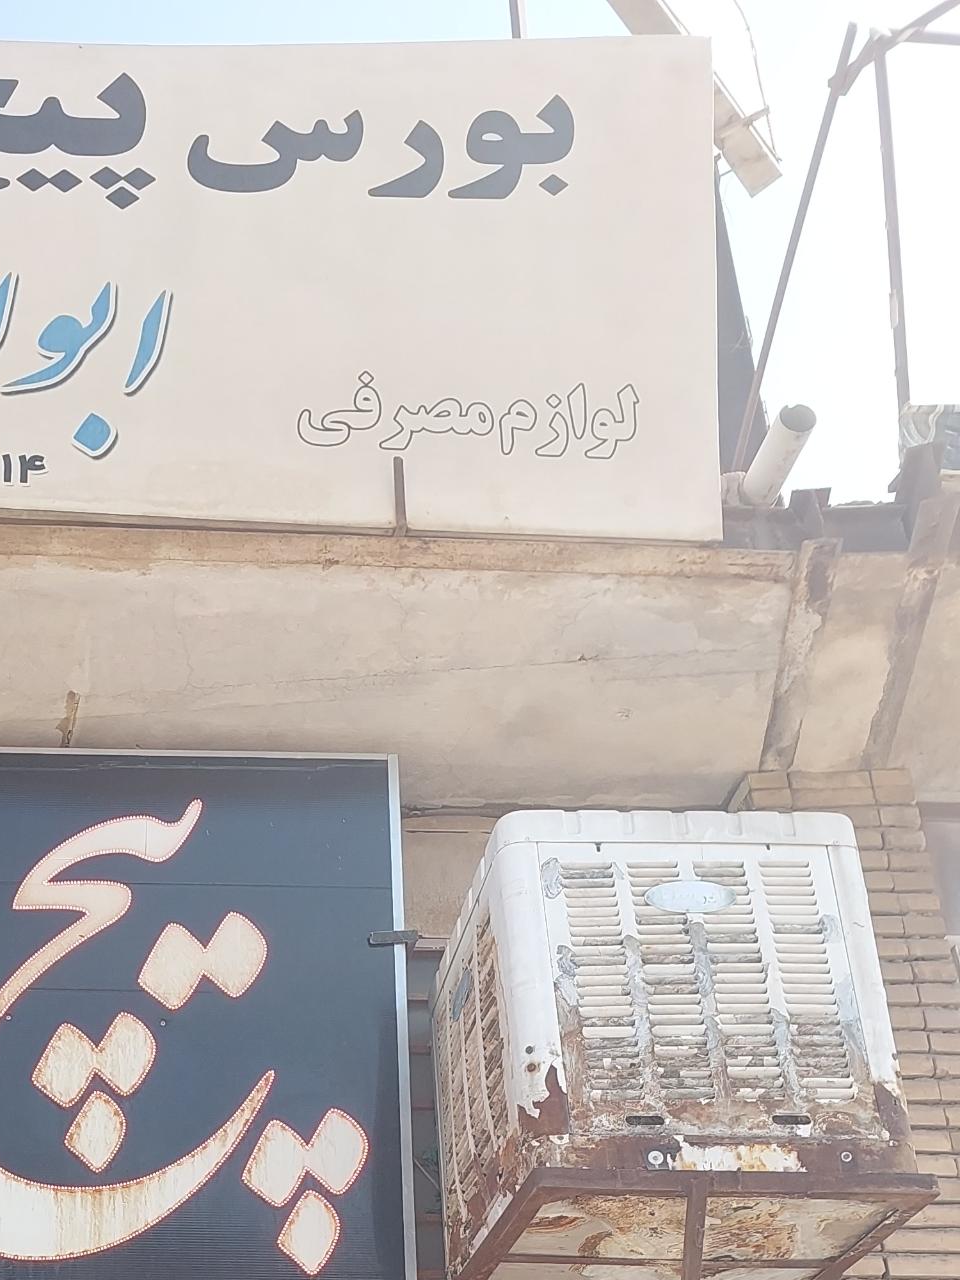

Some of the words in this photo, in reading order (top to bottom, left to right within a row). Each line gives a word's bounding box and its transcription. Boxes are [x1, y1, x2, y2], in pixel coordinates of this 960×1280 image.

[187, 93, 575, 200] بورس
[297, 370, 494, 450] مصرفی
[499, 383, 640, 459] لوازم
